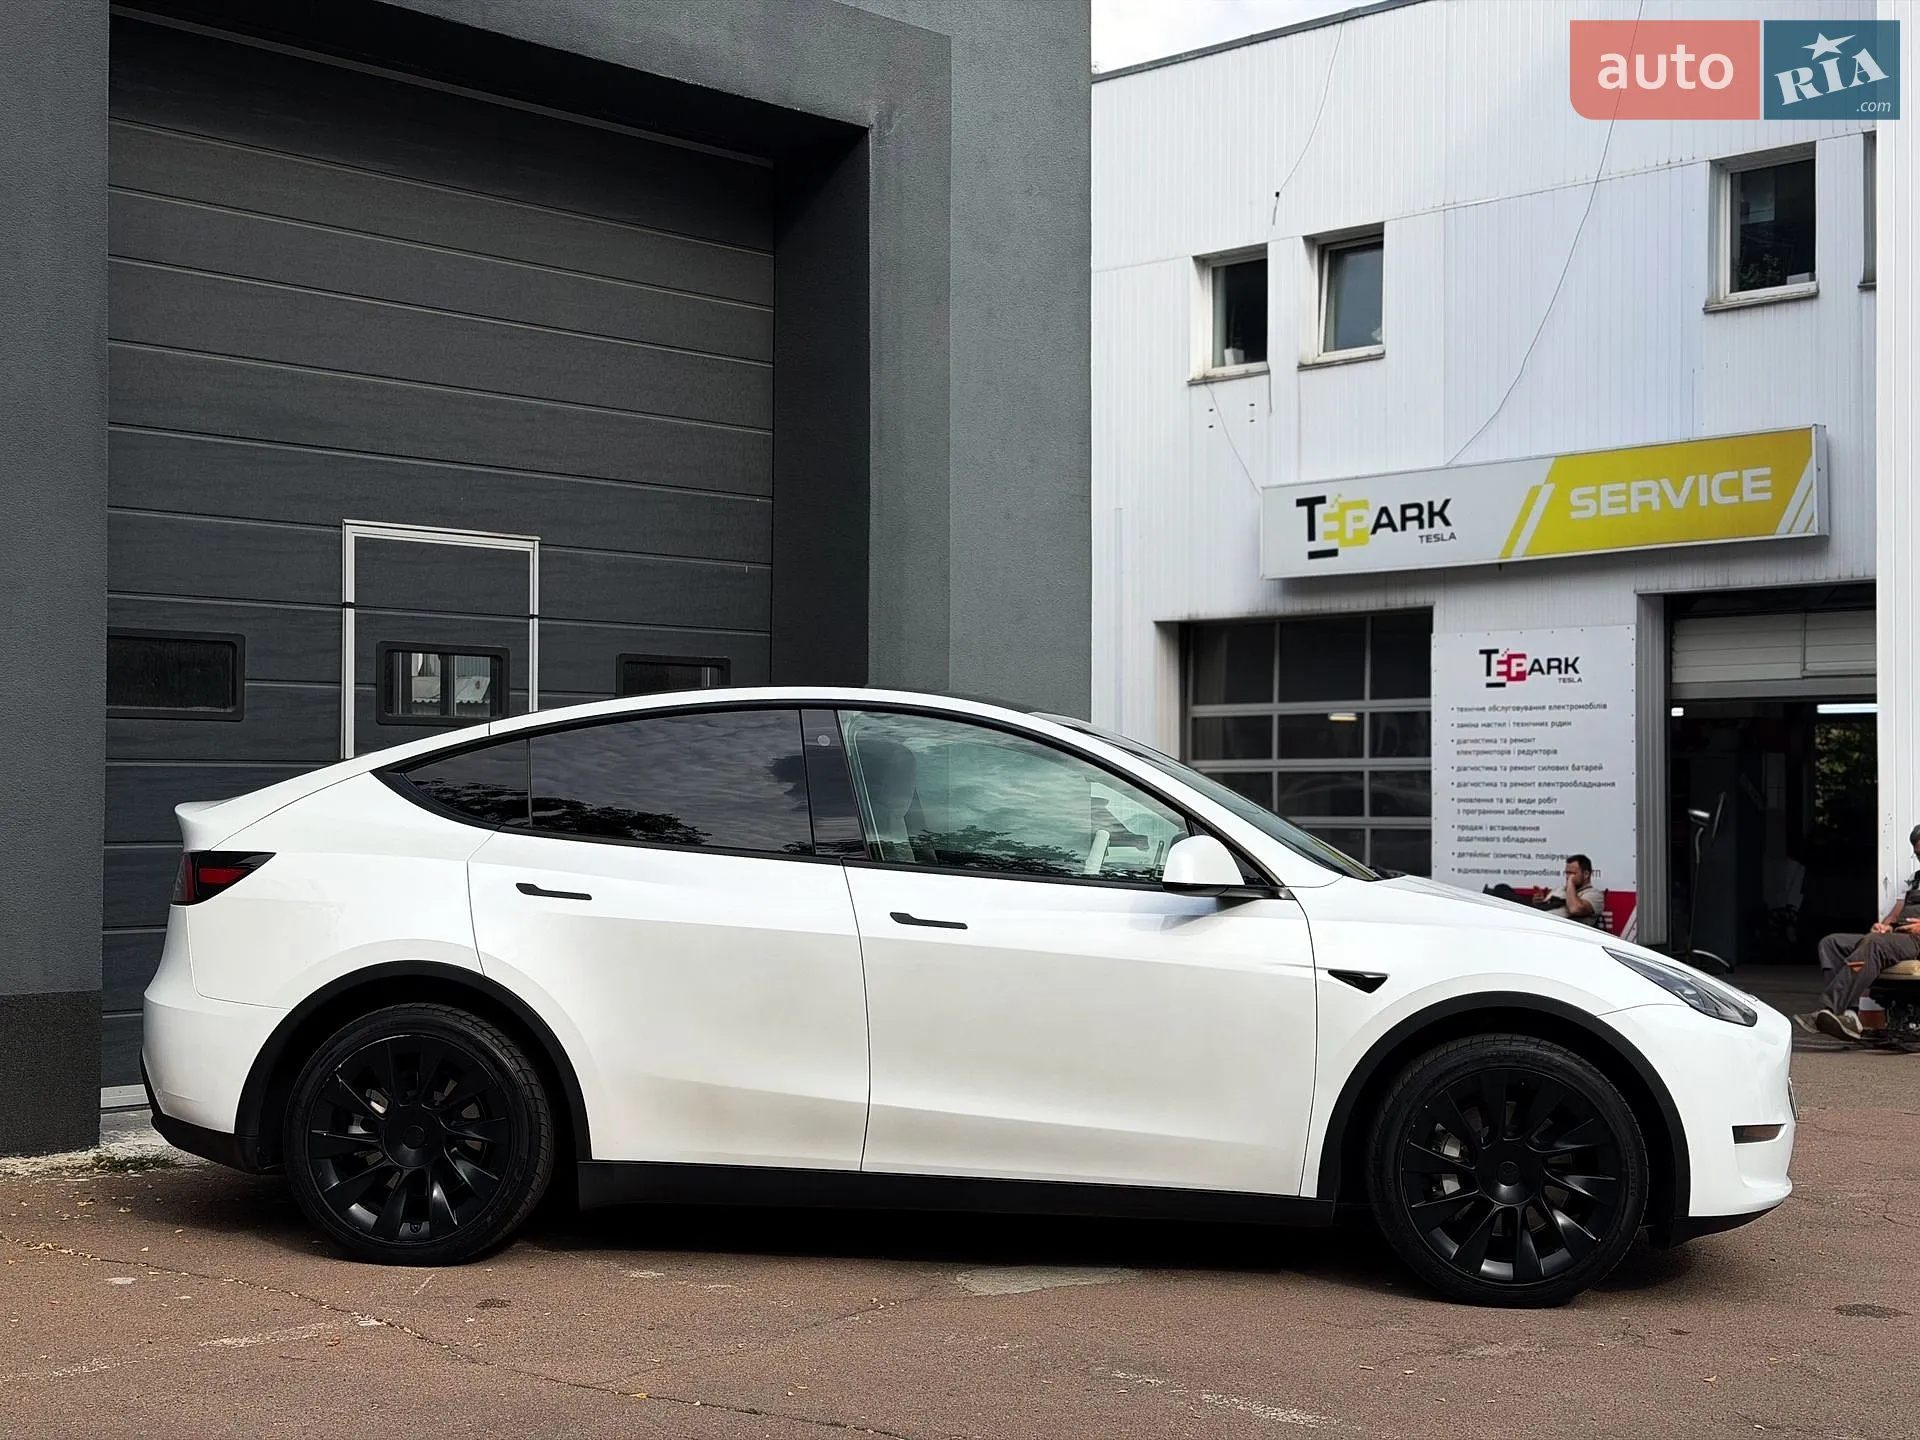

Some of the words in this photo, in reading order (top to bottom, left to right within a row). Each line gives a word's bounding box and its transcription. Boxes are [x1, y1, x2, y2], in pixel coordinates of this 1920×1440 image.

[1570, 467, 1772, 520] SERVICE
[1419, 532, 1457, 544] TESLA
[1538, 797, 1557, 805] робіт
